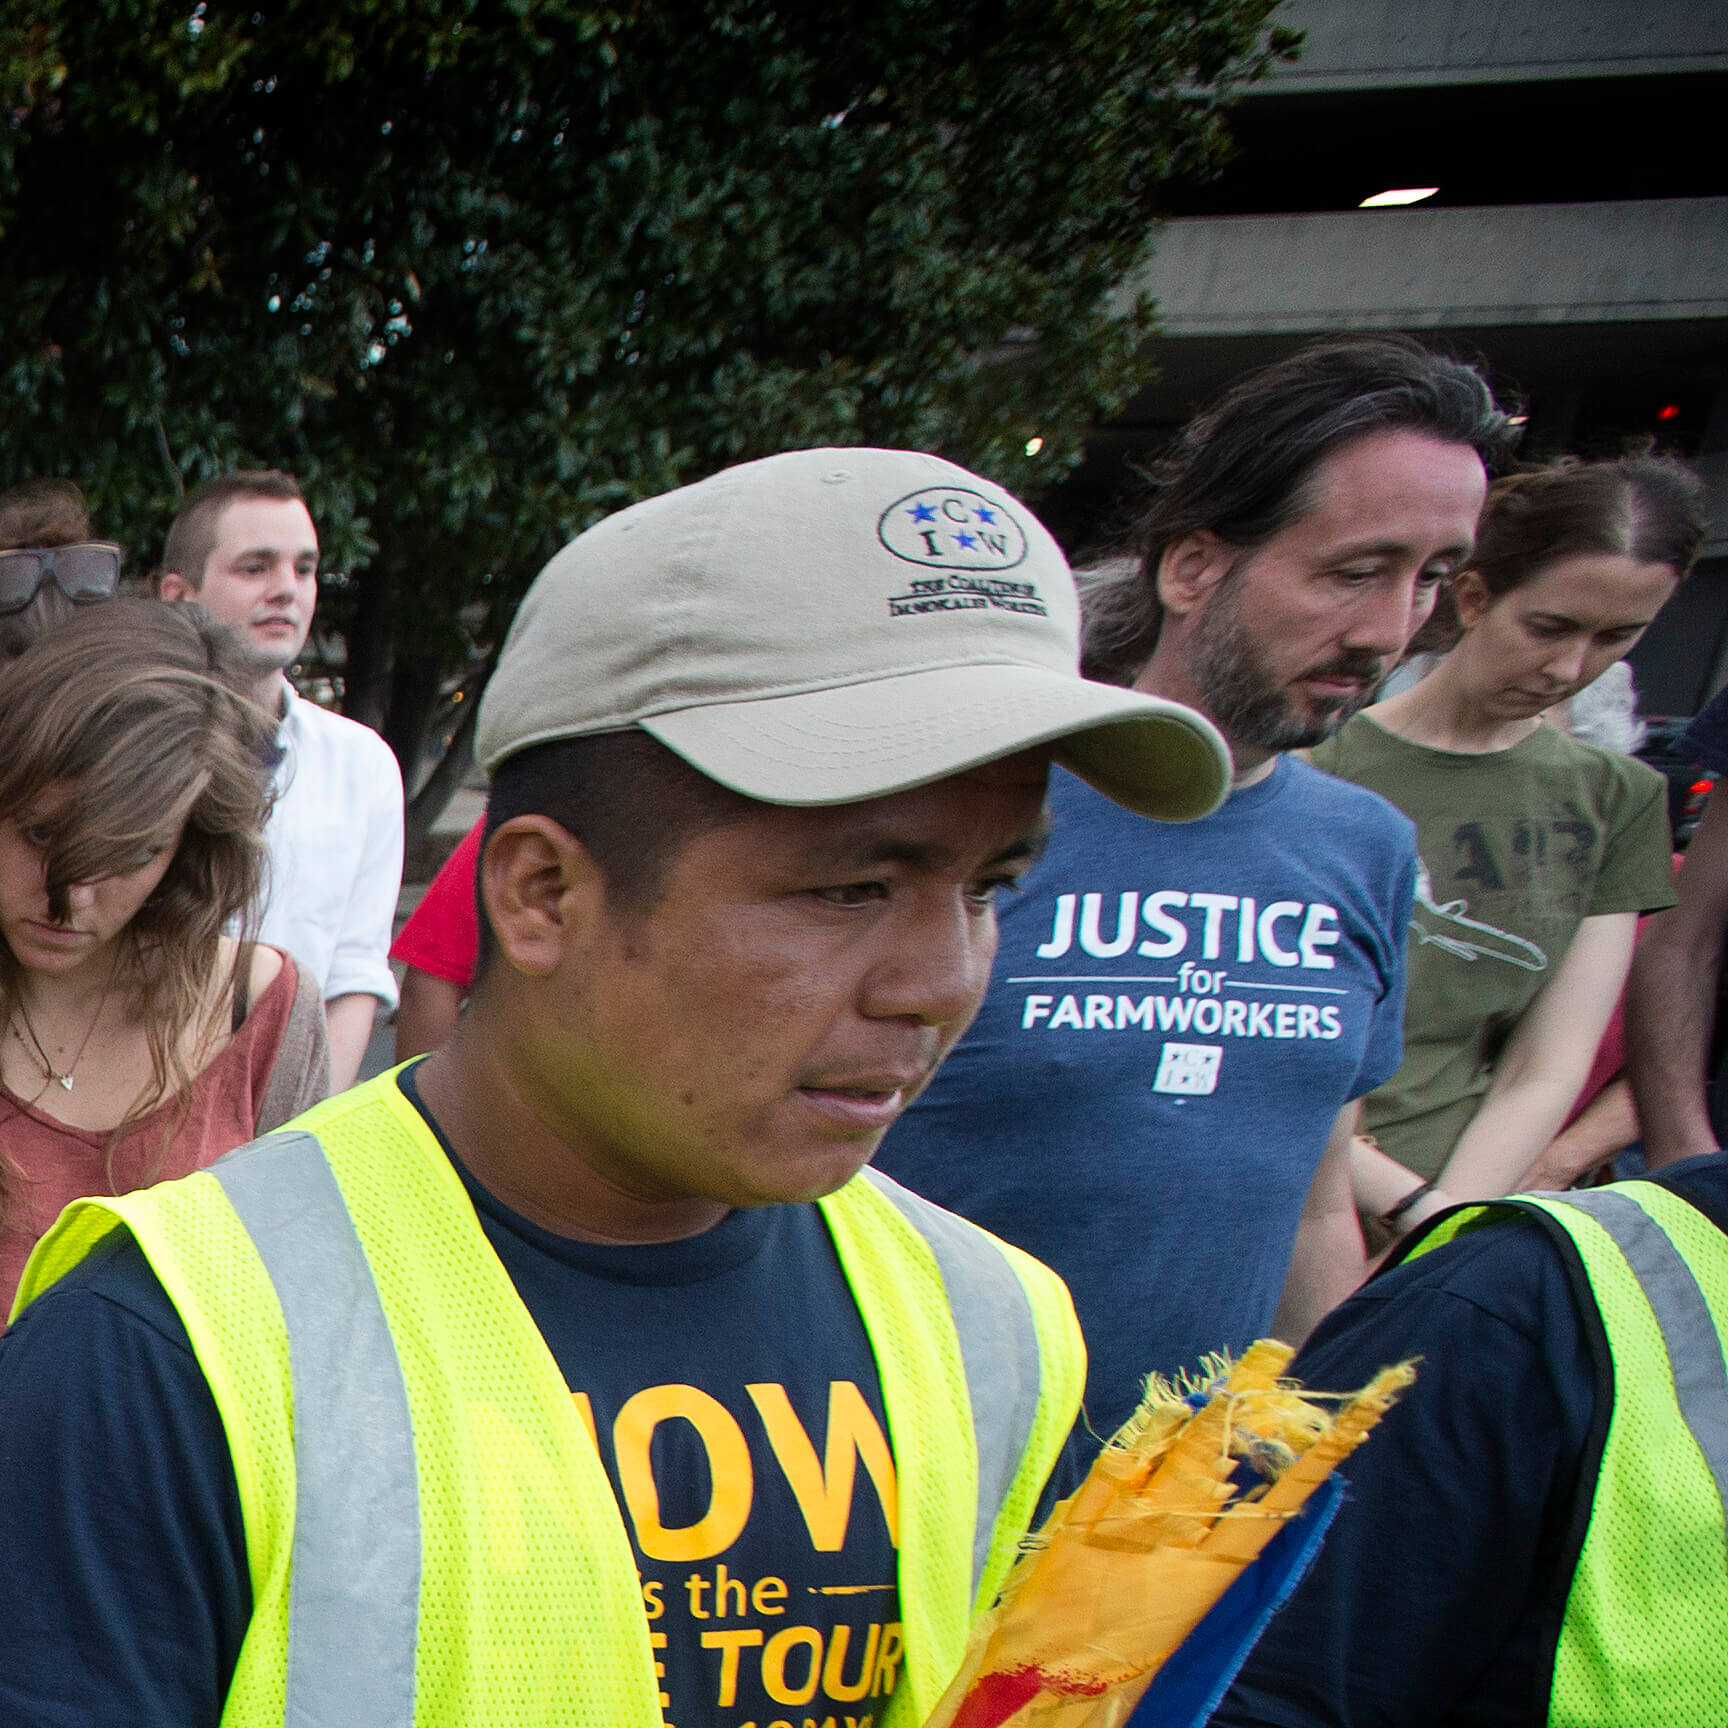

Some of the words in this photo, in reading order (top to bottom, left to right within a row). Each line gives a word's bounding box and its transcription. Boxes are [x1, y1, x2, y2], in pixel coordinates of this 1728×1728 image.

[941, 499, 968, 524] C
[917, 530, 944, 557] I
[975, 530, 1007, 559] W
[1036, 890, 1342, 971] JUSTICE
[1177, 960, 1228, 996] for
[1021, 992, 1346, 1042] FARMWORKERS
[570, 1380, 900, 1563] OW
[636, 1570, 665, 1619] s
[683, 1563, 789, 1620] the
[700, 1621, 904, 1709] TOUR
